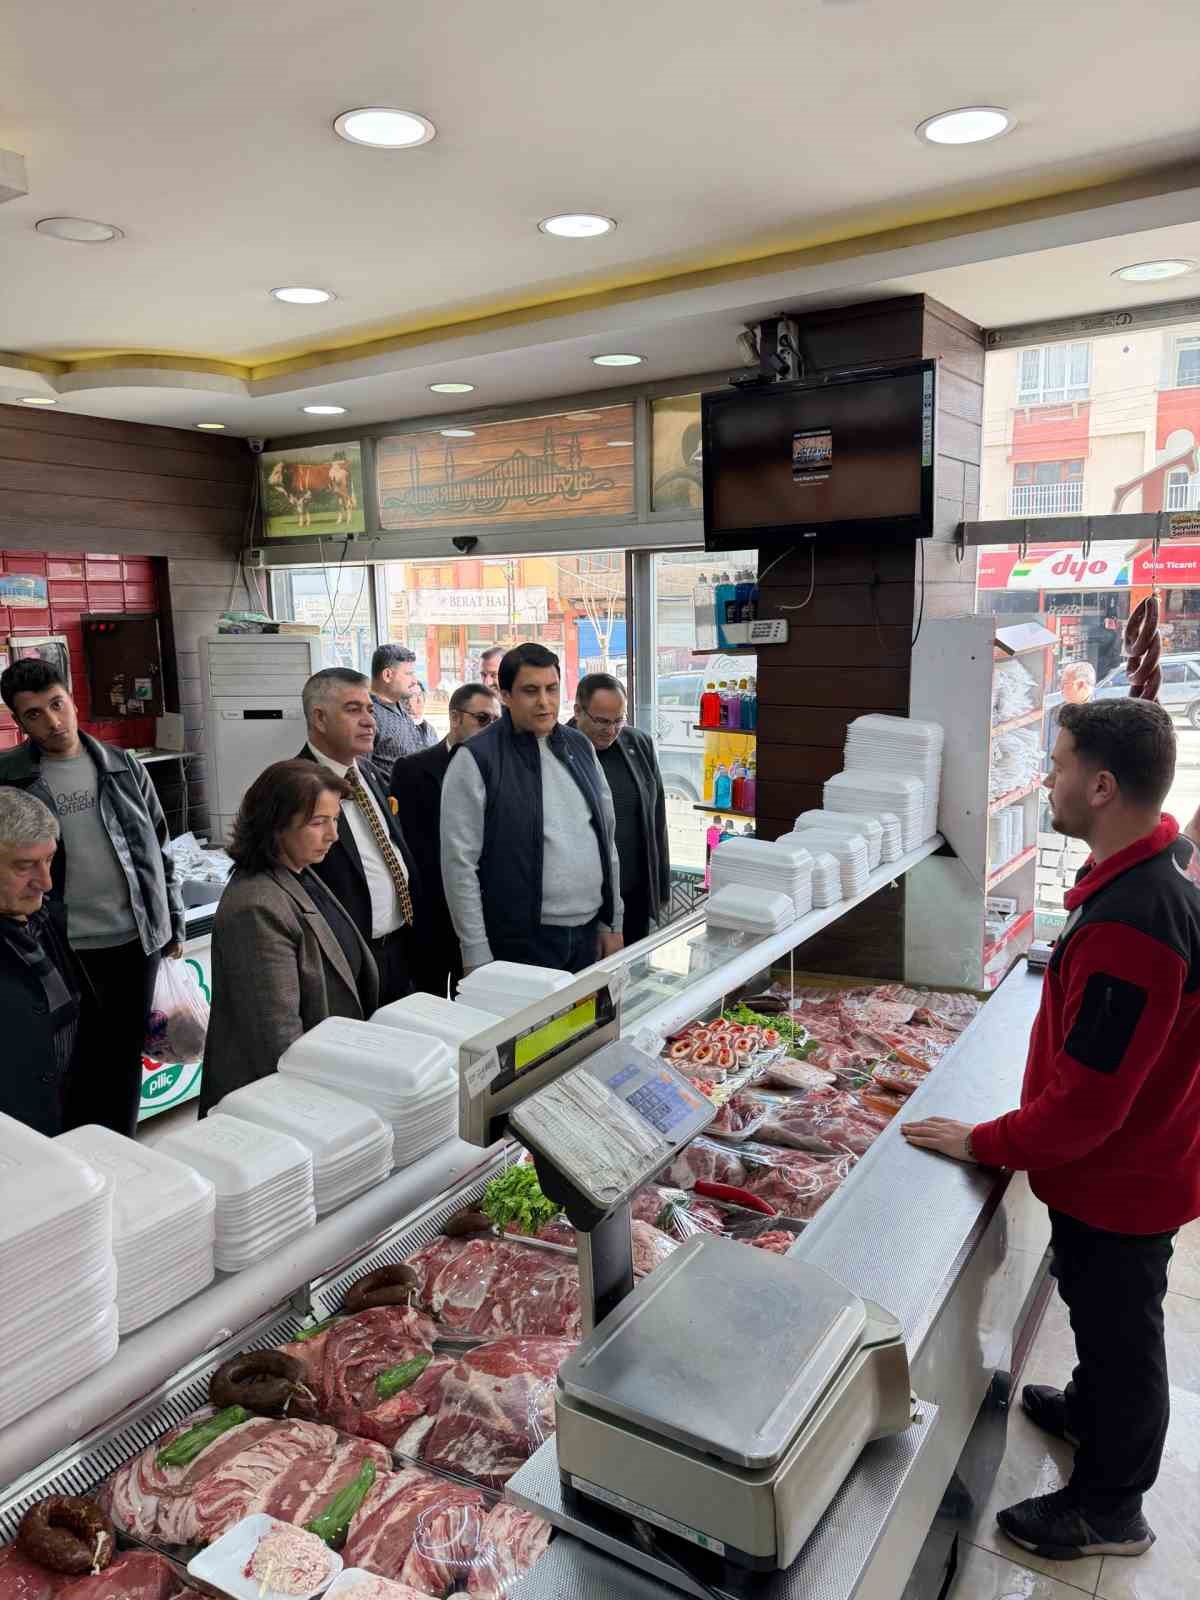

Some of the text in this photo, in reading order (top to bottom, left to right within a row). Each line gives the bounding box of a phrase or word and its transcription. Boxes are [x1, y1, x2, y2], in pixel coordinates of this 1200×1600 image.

[1051, 554, 1108, 582] dyo
[1167, 560, 1196, 570] Ticaret
[449, 595, 481, 607] BERAT
